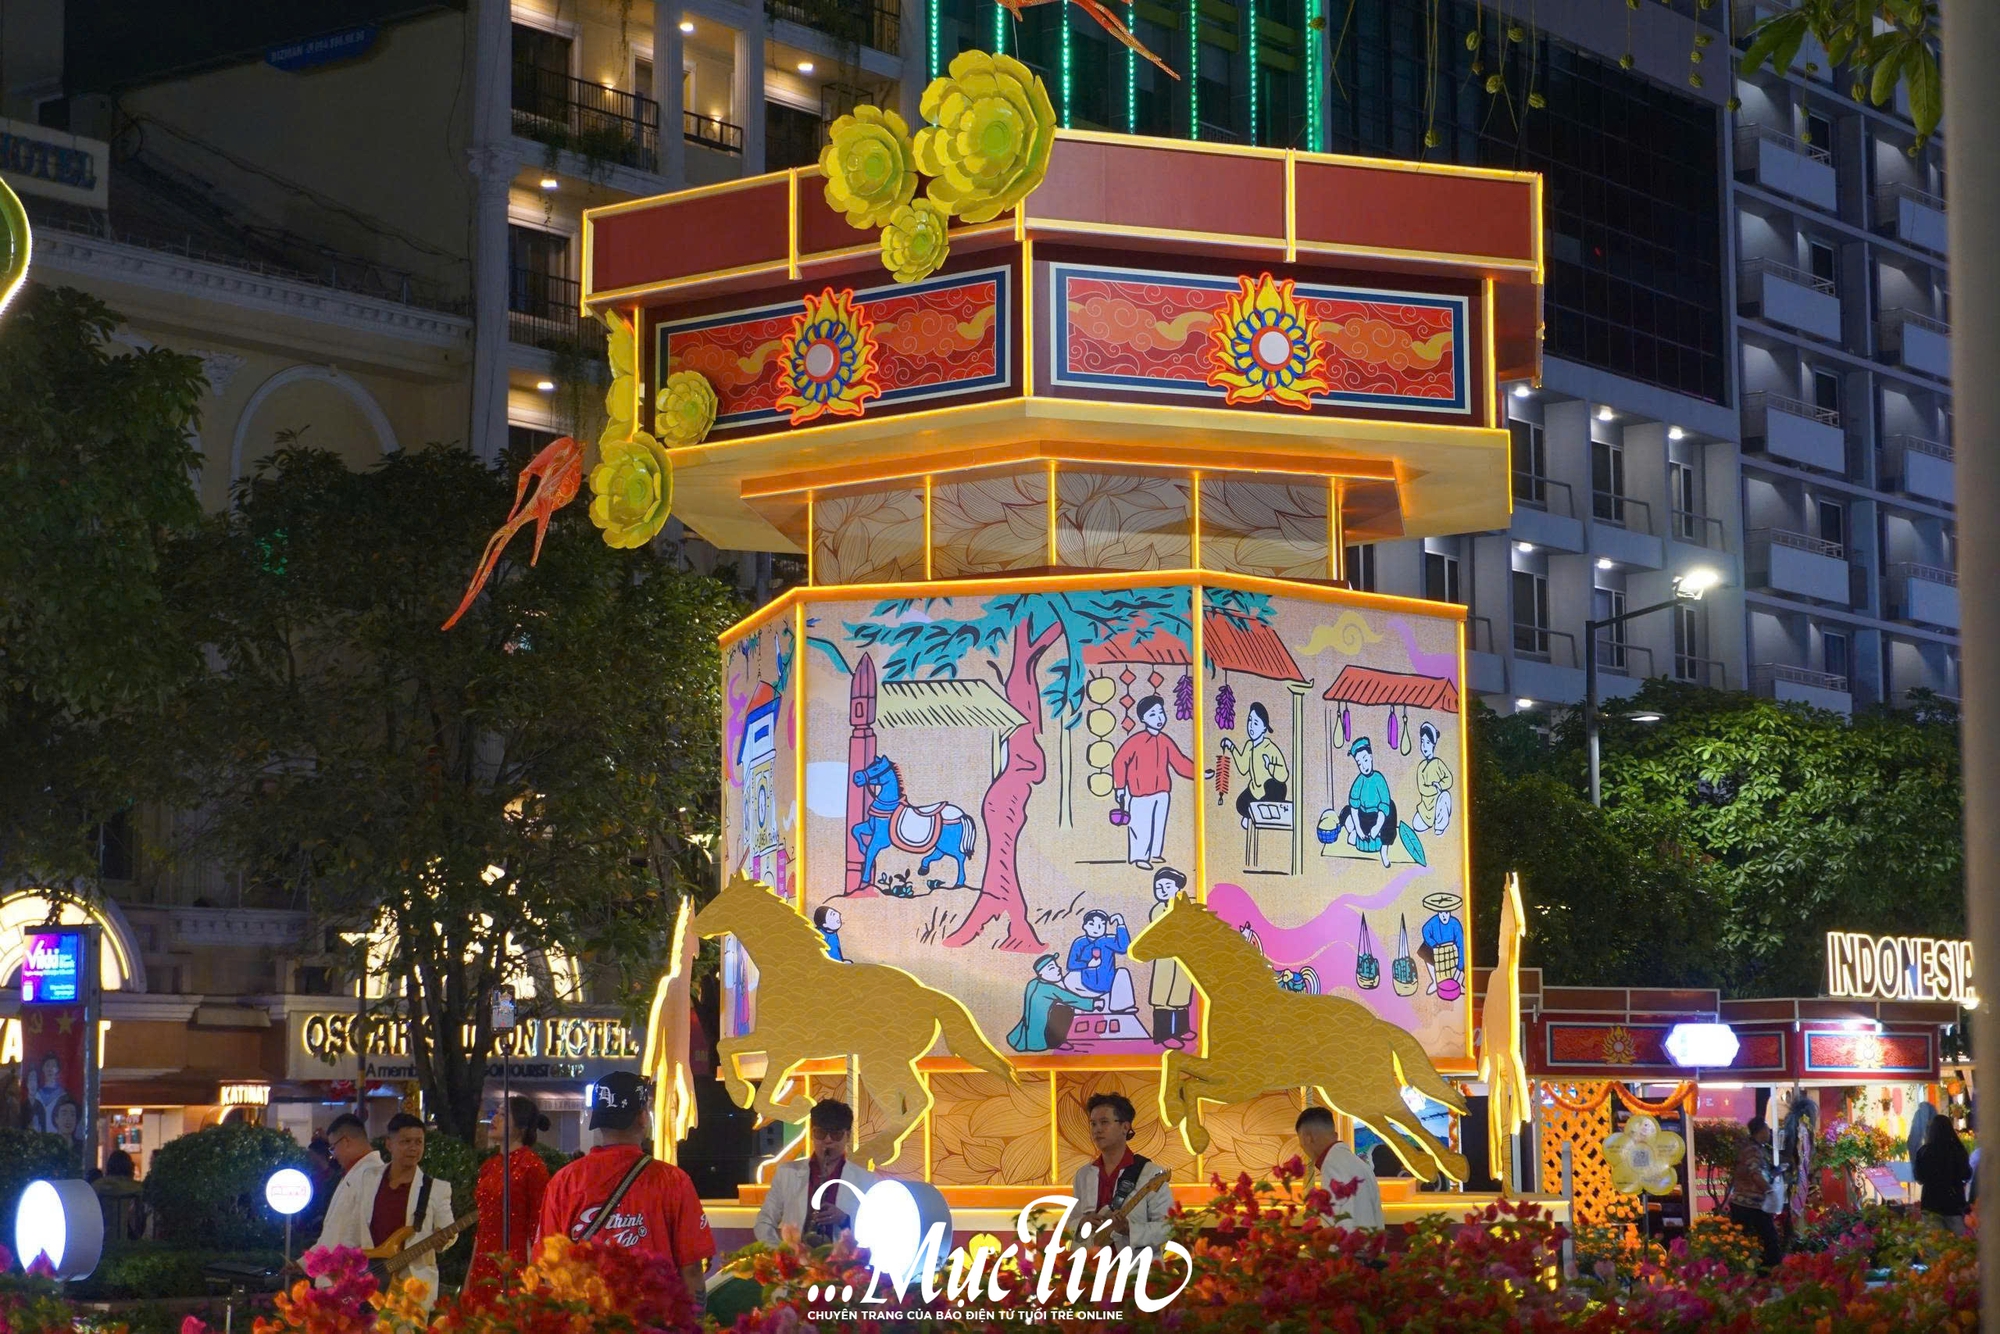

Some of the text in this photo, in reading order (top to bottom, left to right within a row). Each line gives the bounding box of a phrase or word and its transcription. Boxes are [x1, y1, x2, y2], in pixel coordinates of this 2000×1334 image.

[545, 1017, 641, 1059] HOTEL
[366, 1062, 376, 1077] A
[378, 1062, 417, 1078] memb
[221, 1085, 271, 1106] KATINAT
